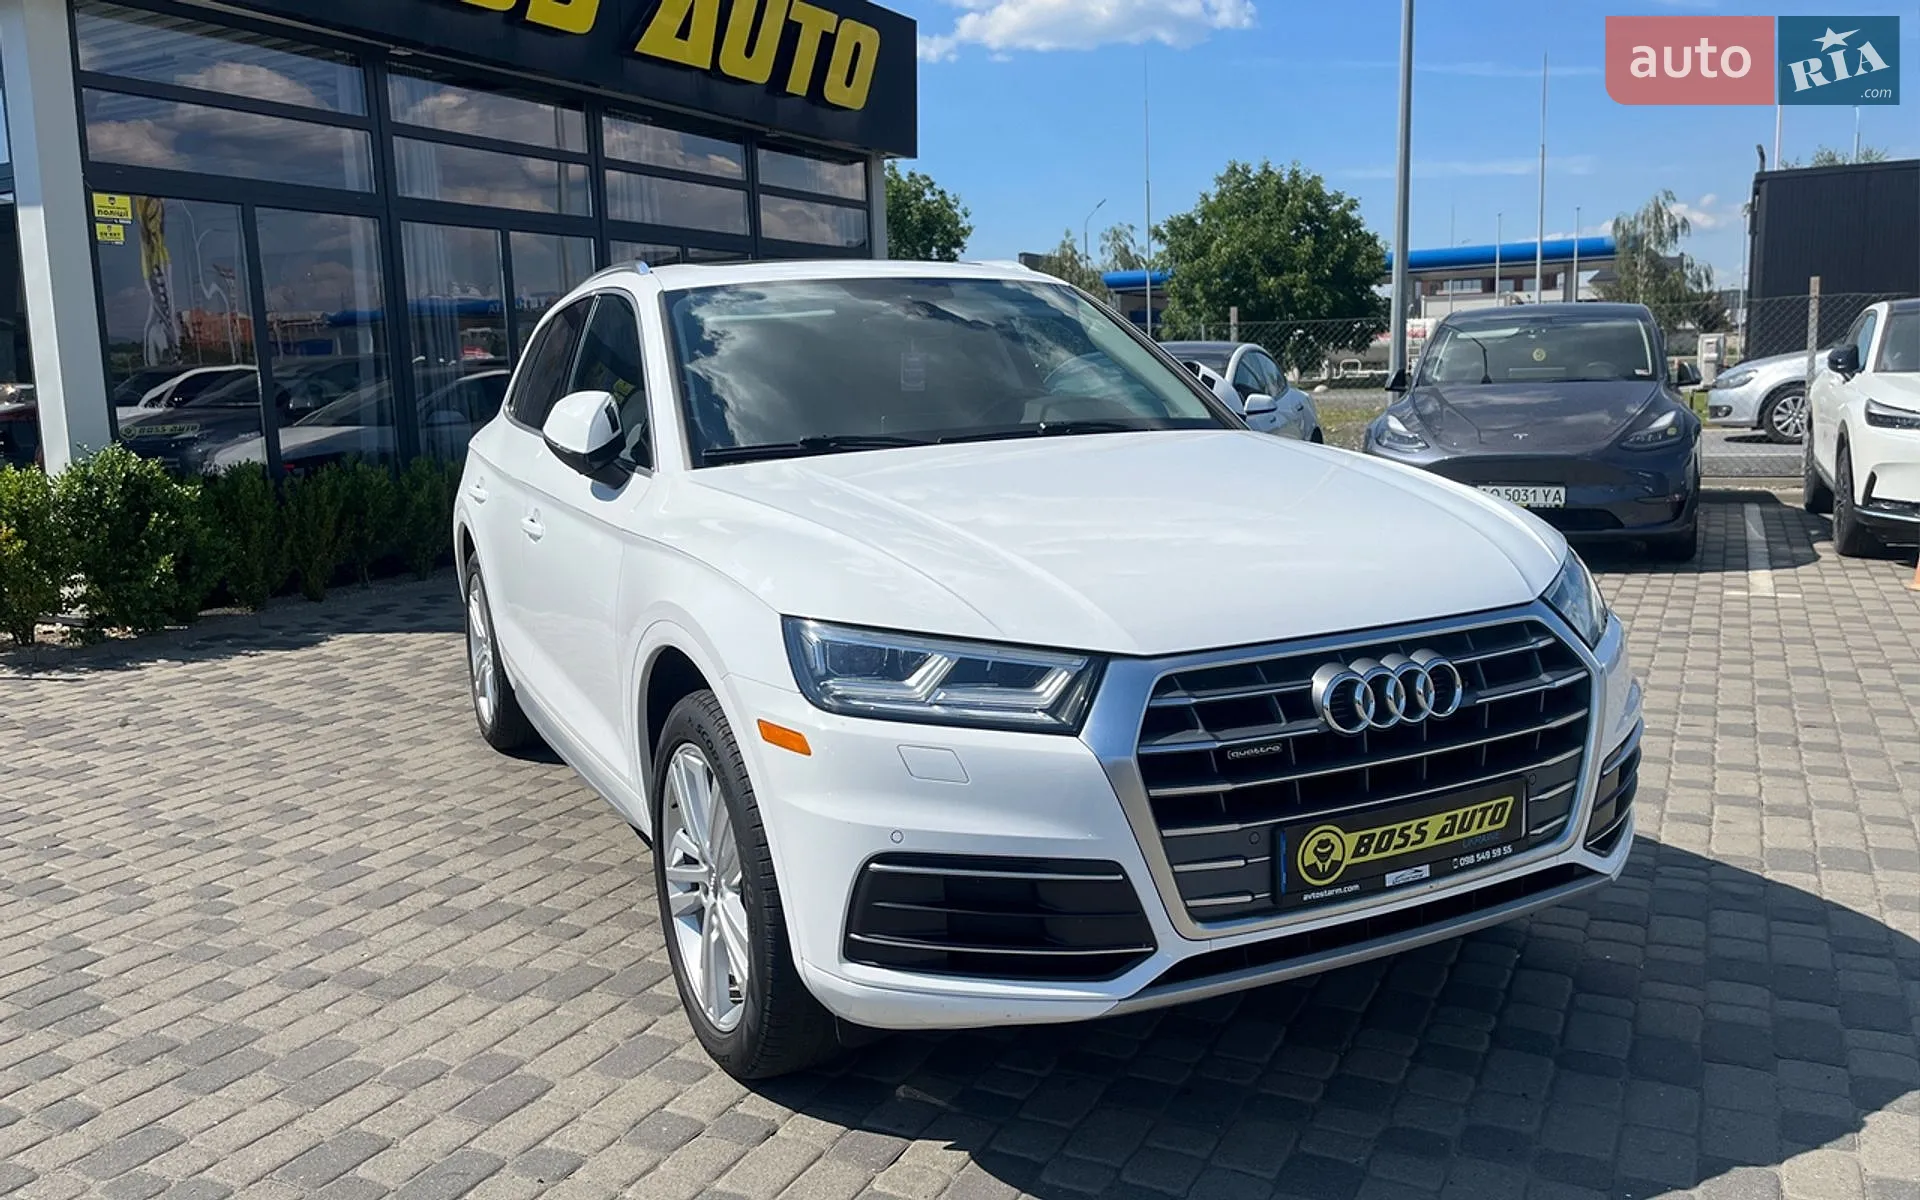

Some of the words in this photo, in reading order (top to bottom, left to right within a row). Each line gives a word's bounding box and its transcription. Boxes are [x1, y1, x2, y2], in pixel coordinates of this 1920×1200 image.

[634, 0, 881, 110] AUTO
[1504, 489, 1538, 502] 5031
[1542, 489, 1563, 503] YA
[1351, 821, 1430, 858] BOSS
[1435, 801, 1509, 839] AUTO
